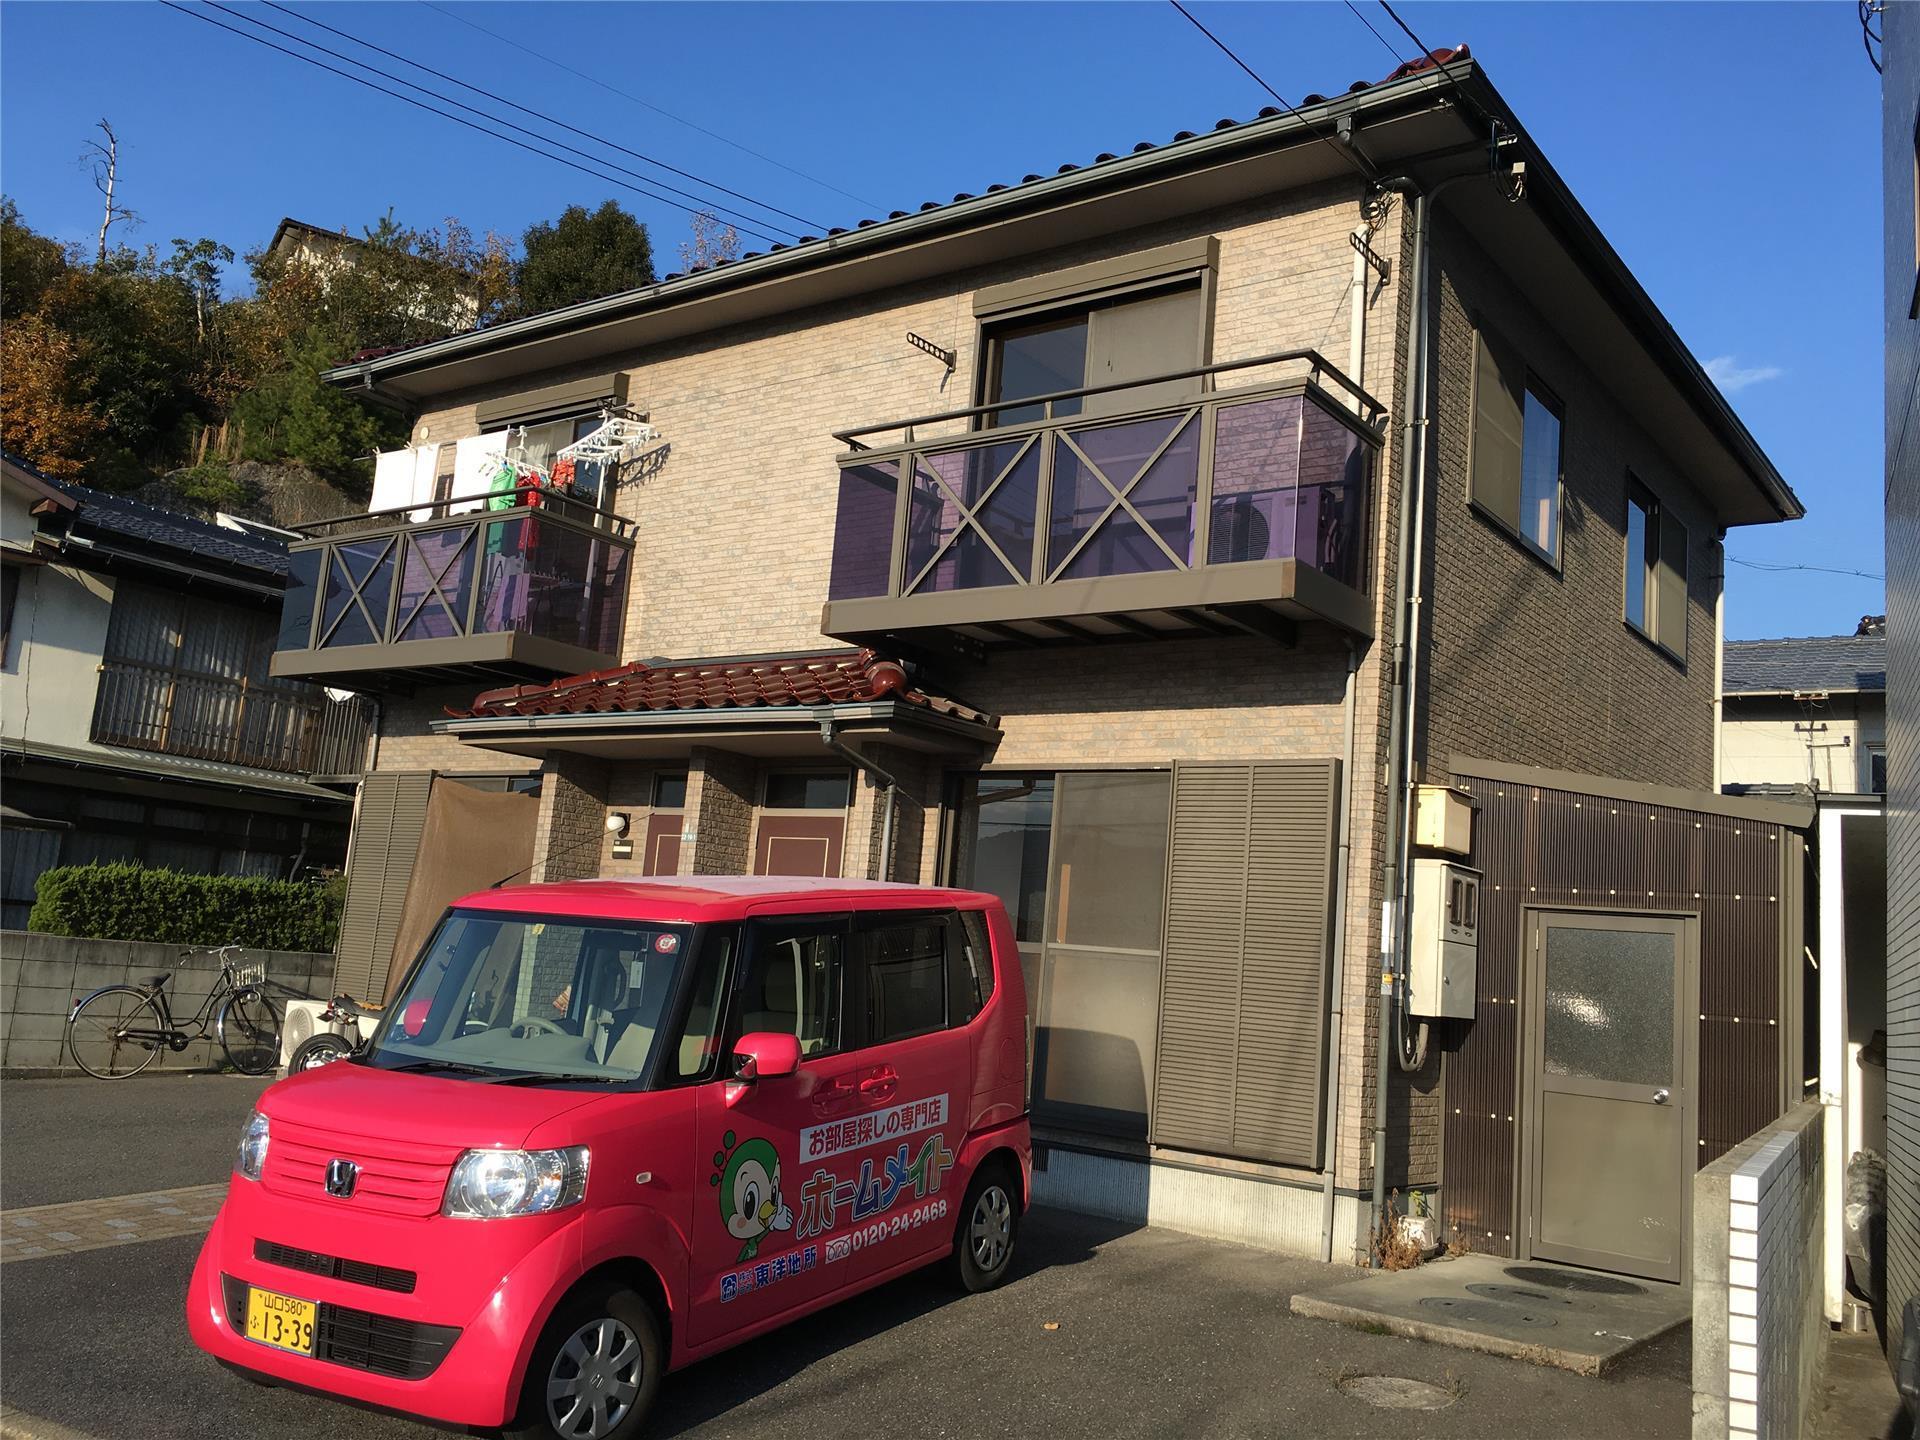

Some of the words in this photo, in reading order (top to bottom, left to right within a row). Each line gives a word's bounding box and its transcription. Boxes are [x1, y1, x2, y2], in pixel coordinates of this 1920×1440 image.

[809, 1100, 941, 1156] お部屋探しの専門店
[796, 1133, 953, 1240] ホームメイト
[753, 1245, 817, 1290] 東洋地所
